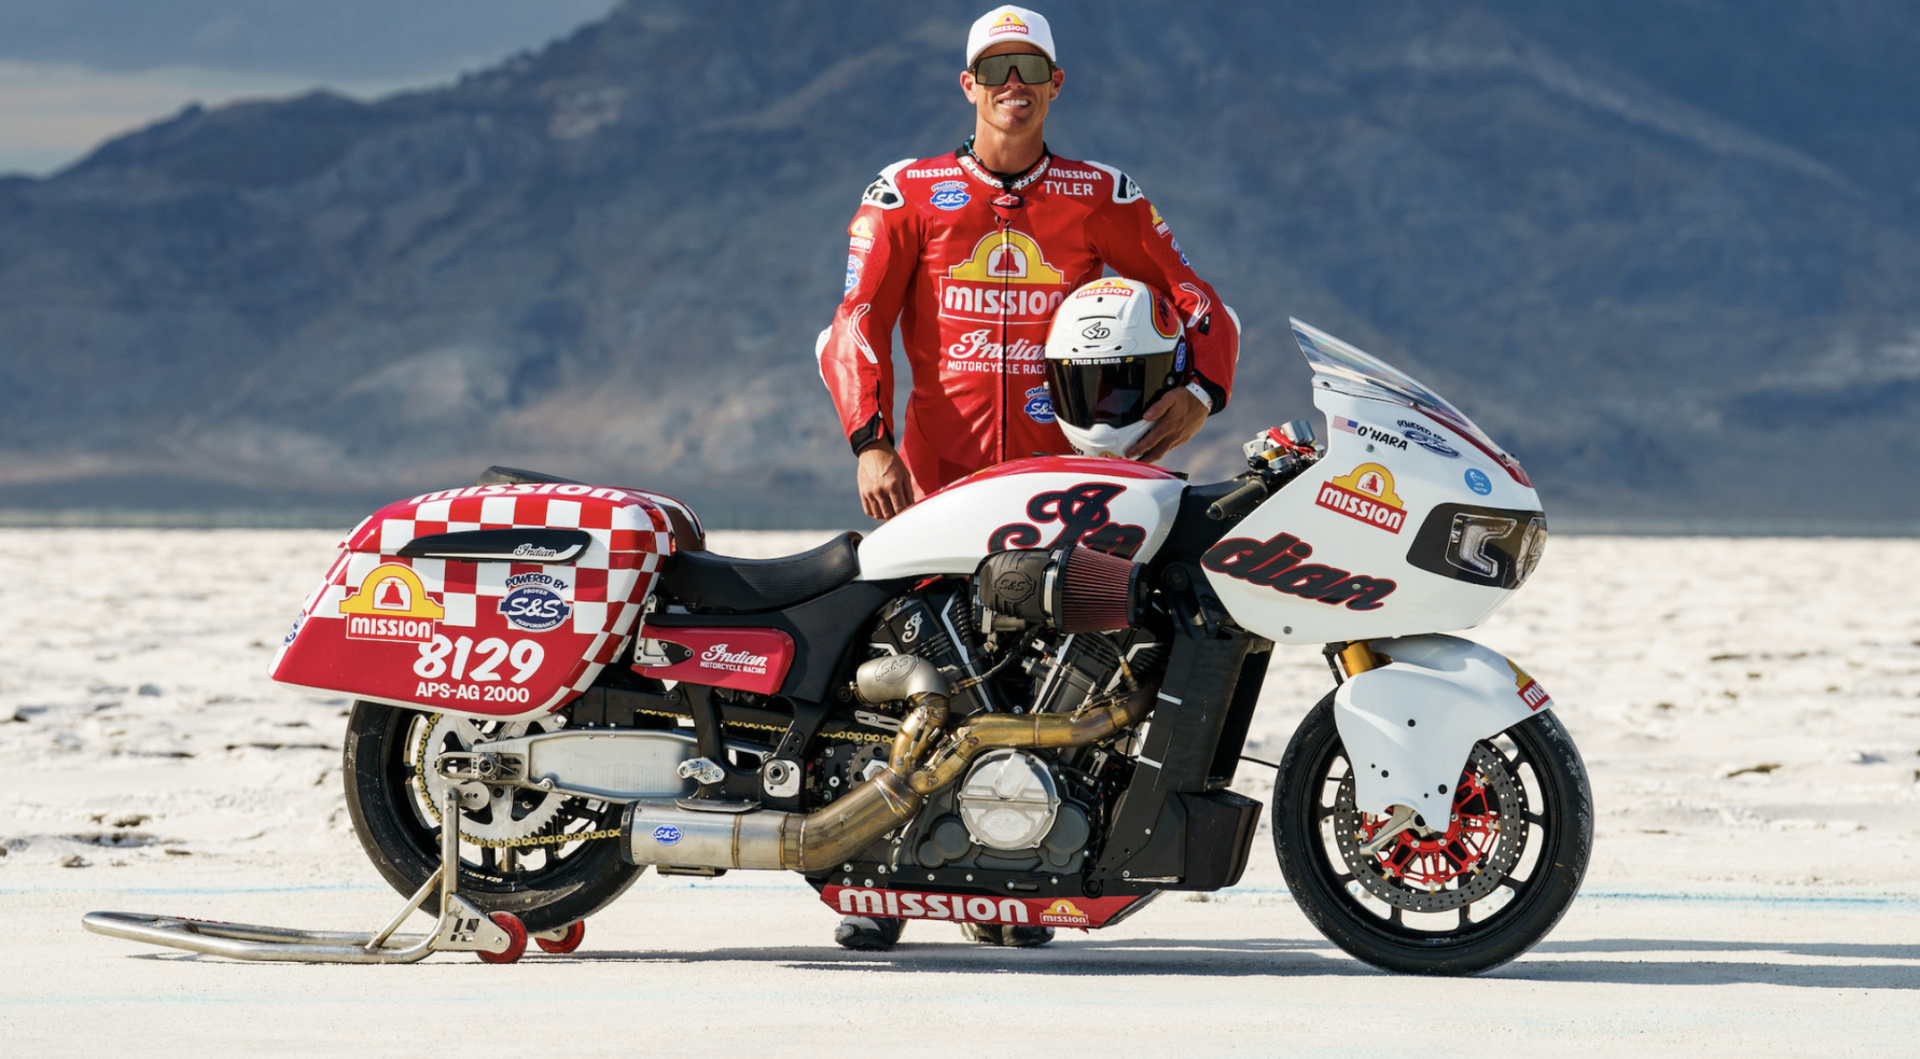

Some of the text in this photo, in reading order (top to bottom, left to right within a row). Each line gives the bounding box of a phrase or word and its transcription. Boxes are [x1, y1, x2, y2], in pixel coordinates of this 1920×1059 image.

[1044, 181, 1093, 195] TYLER
[934, 193, 965, 204] S&S
[948, 329, 1046, 360] India
[1357, 426, 1408, 451] O'HARA
[514, 543, 556, 557] Indian
[505, 573, 568, 590] POWERED BY
[523, 588, 548, 596] PROVEN
[507, 597, 561, 618] S&S
[413, 633, 545, 684] 8129
[701, 643, 768, 667] Indian
[700, 660, 767, 675] MOTORCYCLE RACING
[415, 681, 530, 703] APS-AG 2000
[655, 830, 678, 838] S&S
